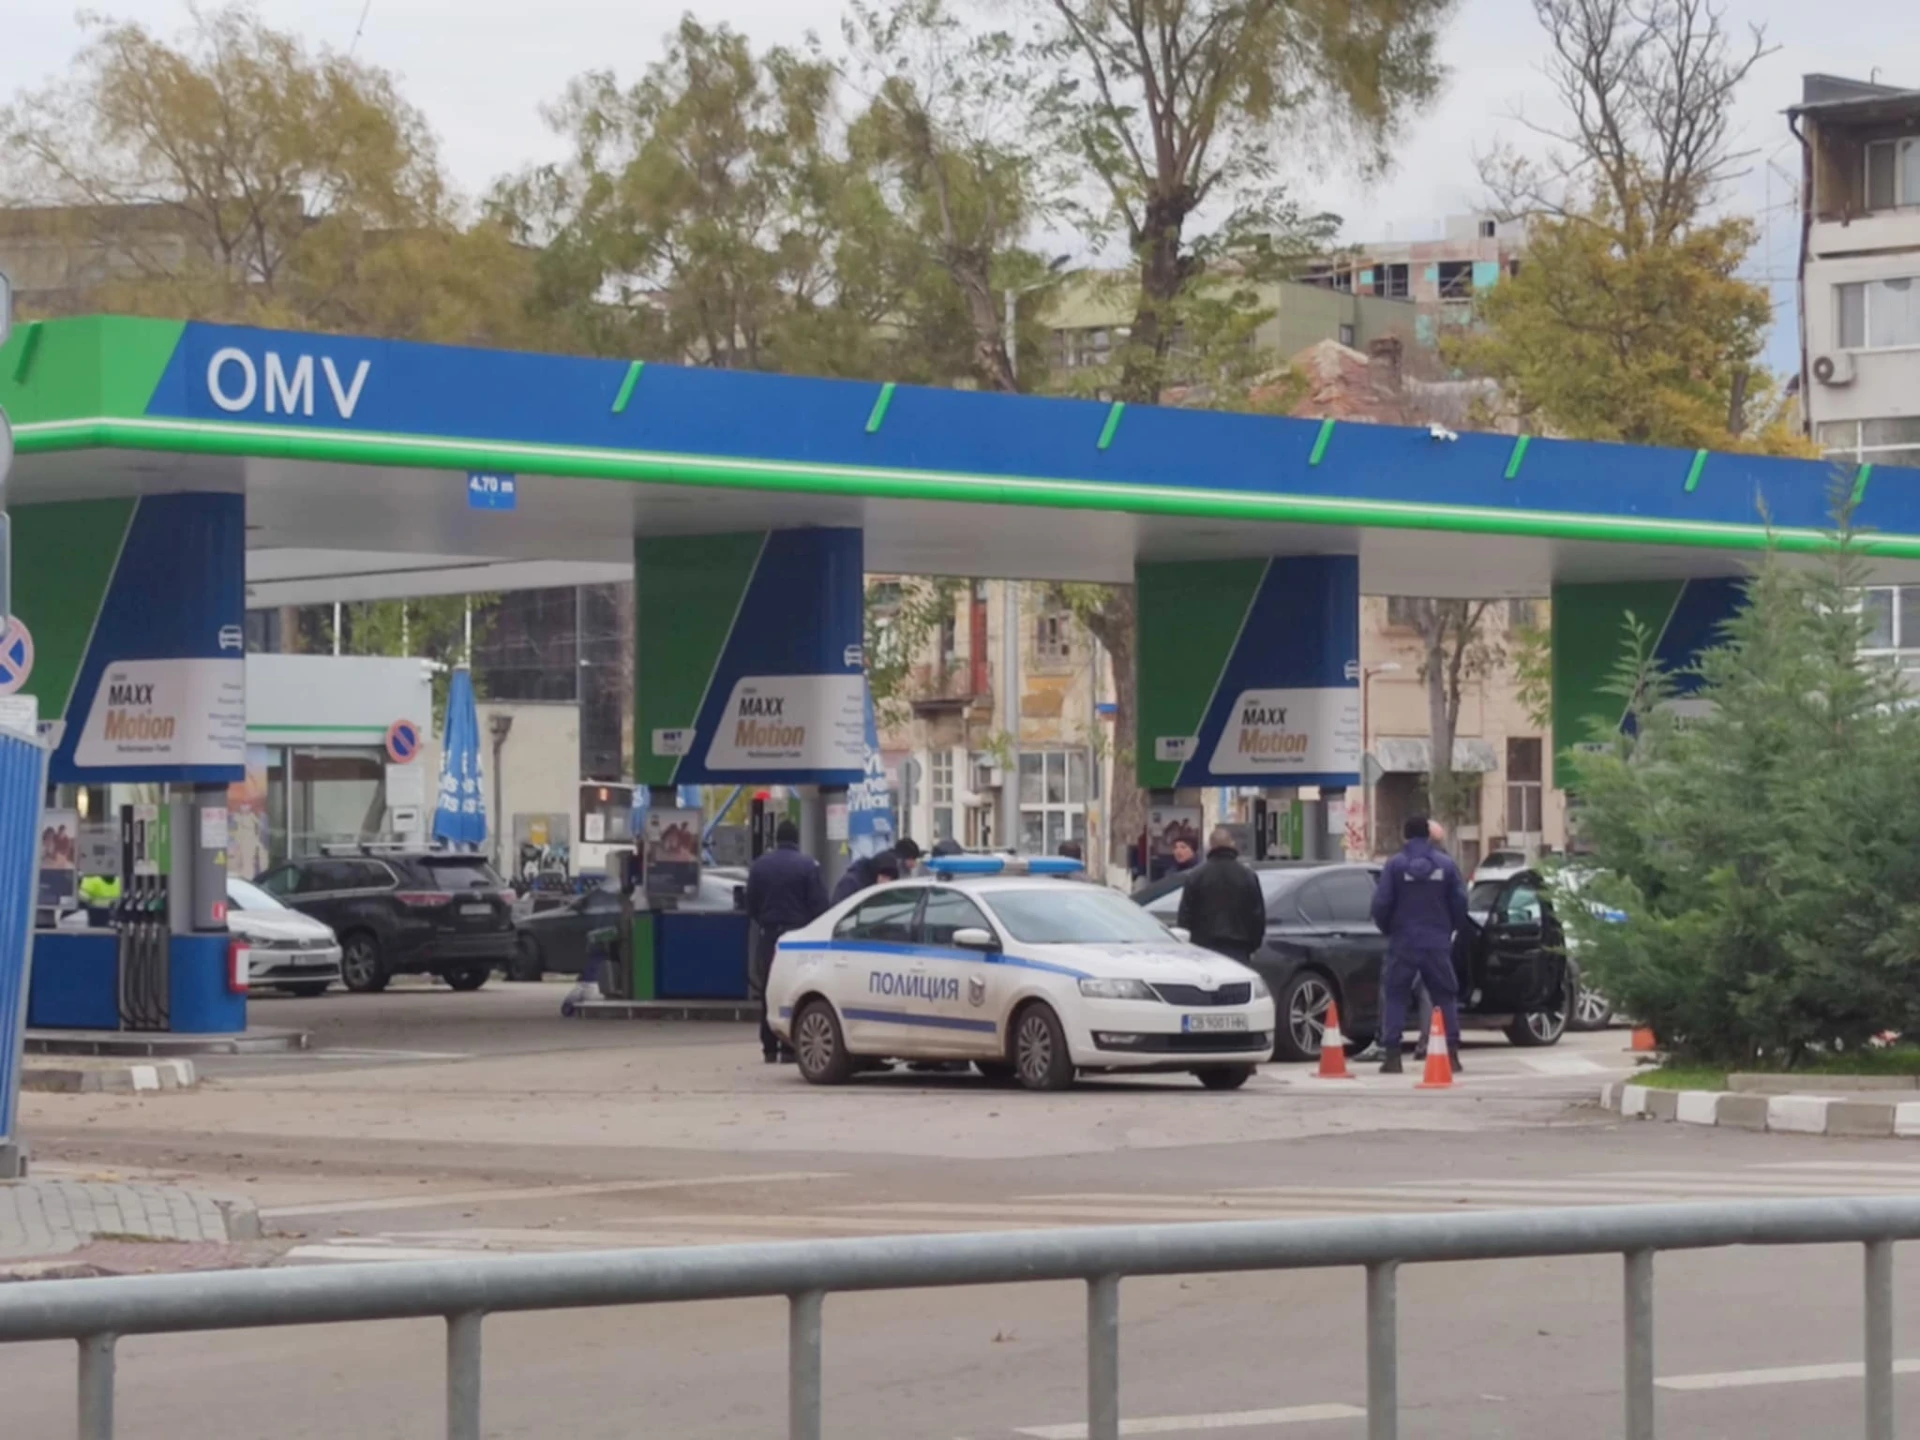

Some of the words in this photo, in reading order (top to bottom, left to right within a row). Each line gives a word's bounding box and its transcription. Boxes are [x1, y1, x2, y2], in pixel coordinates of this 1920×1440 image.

[207, 347, 371, 419] OMV
[469, 477, 498, 492] 4.70
[501, 480, 514, 492] m
[108, 684, 155, 706] MAXX
[738, 697, 785, 717] MAXX
[103, 709, 175, 741] Motion
[1242, 708, 1288, 726] MAXX
[734, 719, 806, 748] Motion
[1238, 728, 1309, 754] Motion
[869, 971, 960, 1003] ПОЛИЦИЯ
